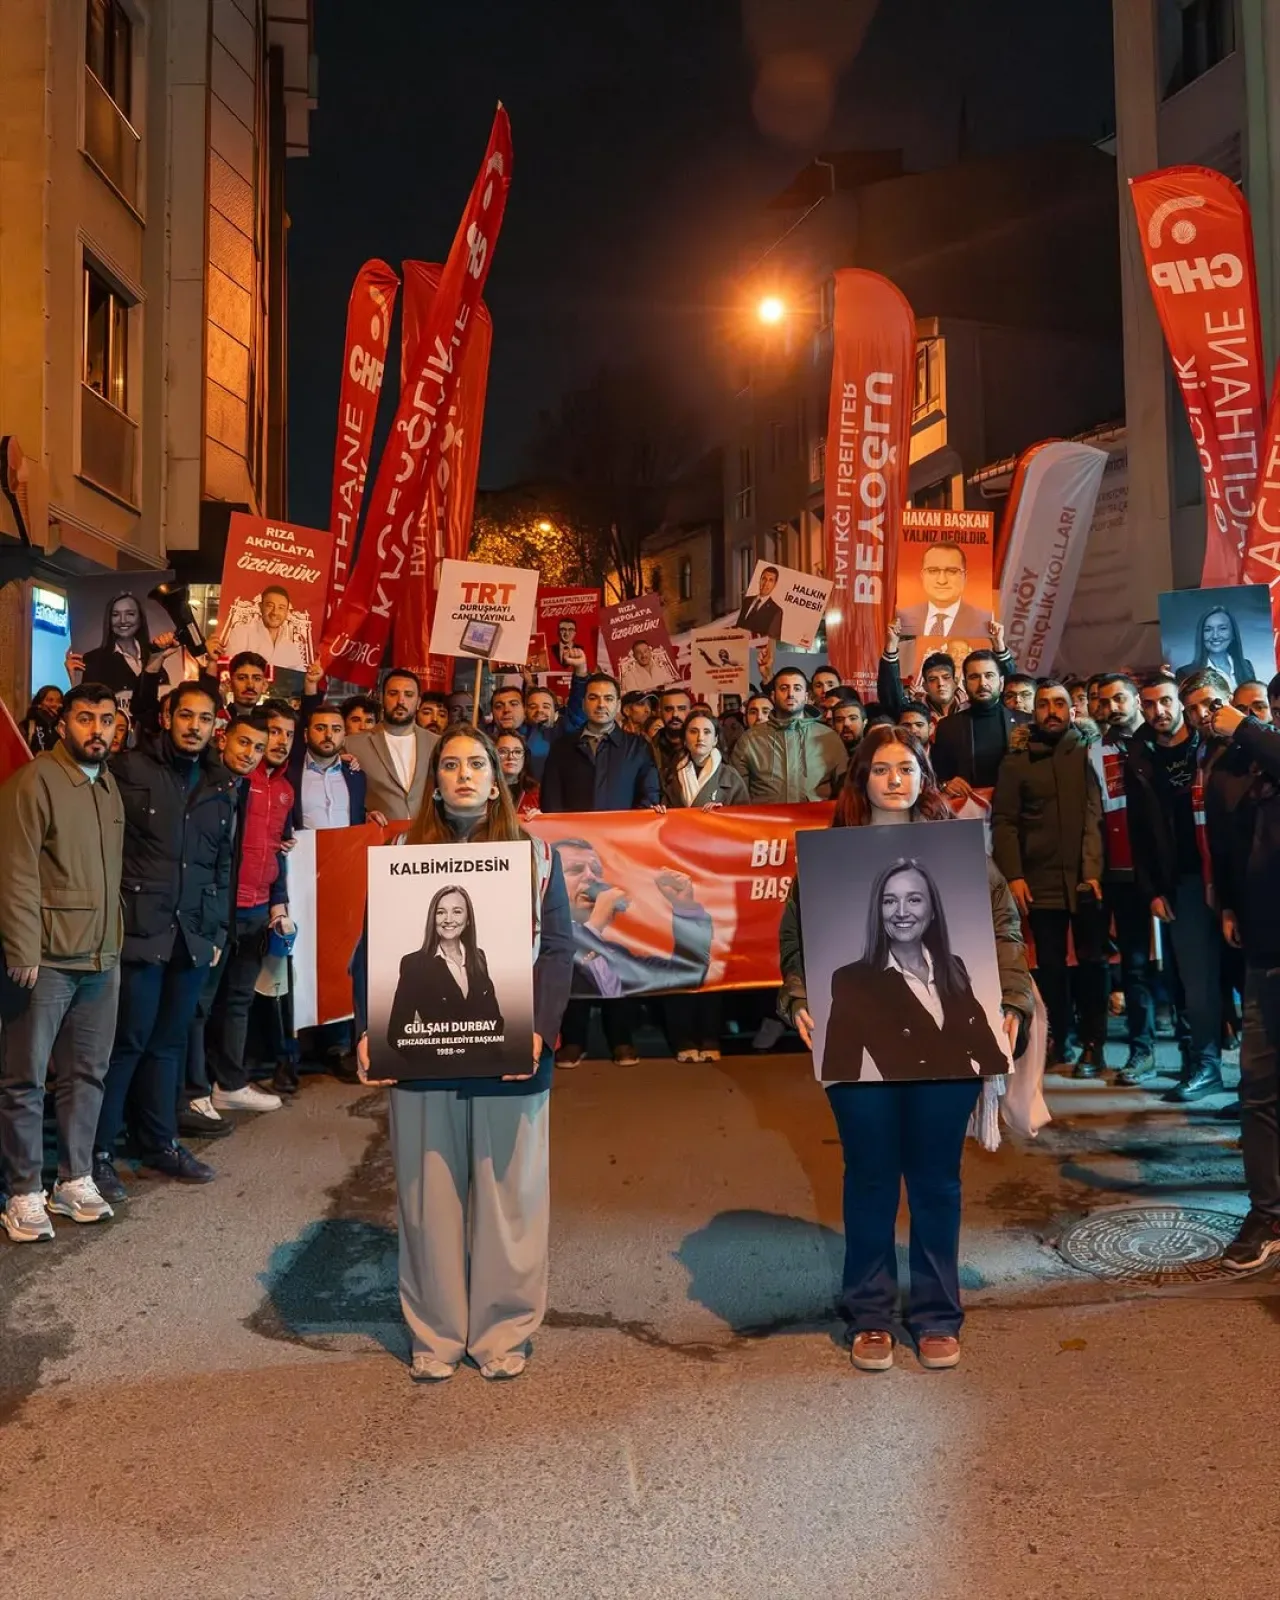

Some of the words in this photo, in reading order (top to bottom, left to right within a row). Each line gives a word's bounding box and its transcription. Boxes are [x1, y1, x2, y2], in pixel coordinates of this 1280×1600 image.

[902, 511, 941, 526] HAKAN
[944, 512, 989, 530] BAŞKAN
[266, 527, 295, 541] RIZA
[902, 528, 938, 543] YALNIZ
[245, 536, 315, 558] AKPOLAT'A
[237, 552, 321, 583] ÖZGÜRLÜK!
[461, 582, 516, 604] TRT
[793, 584, 827, 600] HALKIN
[1025, 592, 1056, 672] GENÇLİK
[1045, 506, 1076, 588] KOLLARI
[460, 604, 511, 613] DURUŞMAYI
[785, 591, 822, 612] İRADESİ!
[480, 613, 516, 622] YAYINLA
[611, 618, 660, 640] ÖZGÜRLÜK!
[751, 839, 788, 867] BU
[390, 856, 510, 875] KALBİMİZDESİN
[750, 876, 793, 902] BAŞ
[404, 1020, 449, 1036] GÜLŞAH
[451, 1020, 497, 1032] DURBAY
[397, 1037, 441, 1048] ŞEHZADELER
[441, 1035, 474, 1045] BELEDİYE
[474, 1035, 505, 1044] BAŞKANI
